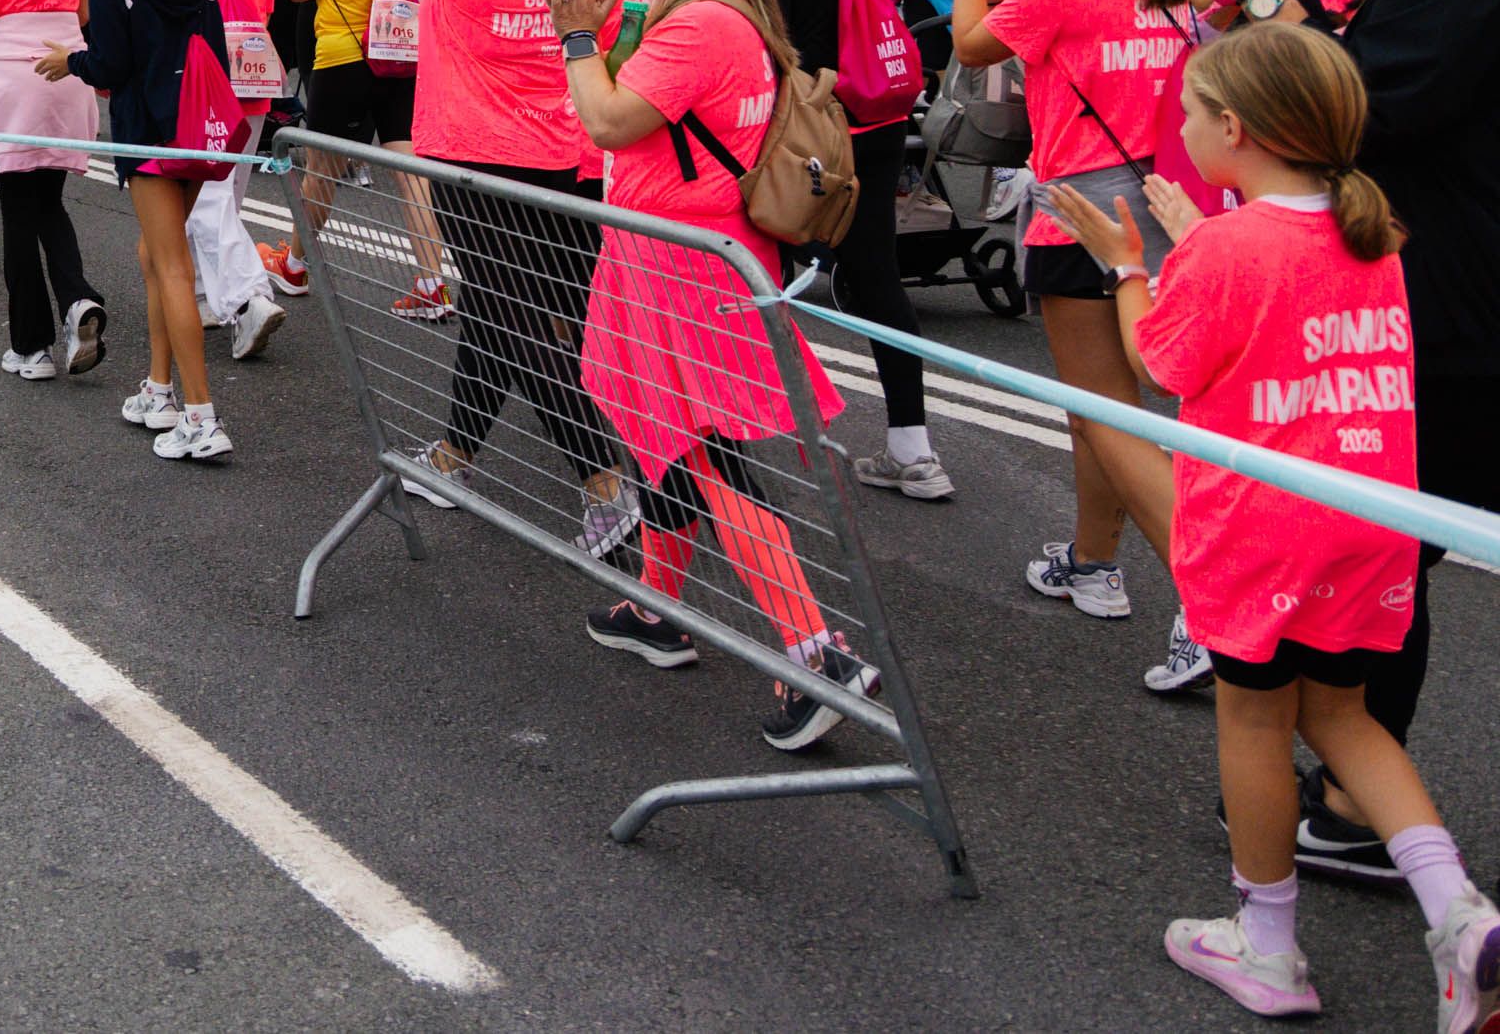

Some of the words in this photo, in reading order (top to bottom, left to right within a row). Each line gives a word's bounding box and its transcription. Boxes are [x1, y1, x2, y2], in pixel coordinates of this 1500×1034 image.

[392, 26, 414, 39] 016
[244, 62, 267, 74] 016
[1303, 306, 1409, 364] SOMOS
[1336, 427, 1384, 455] 2026
